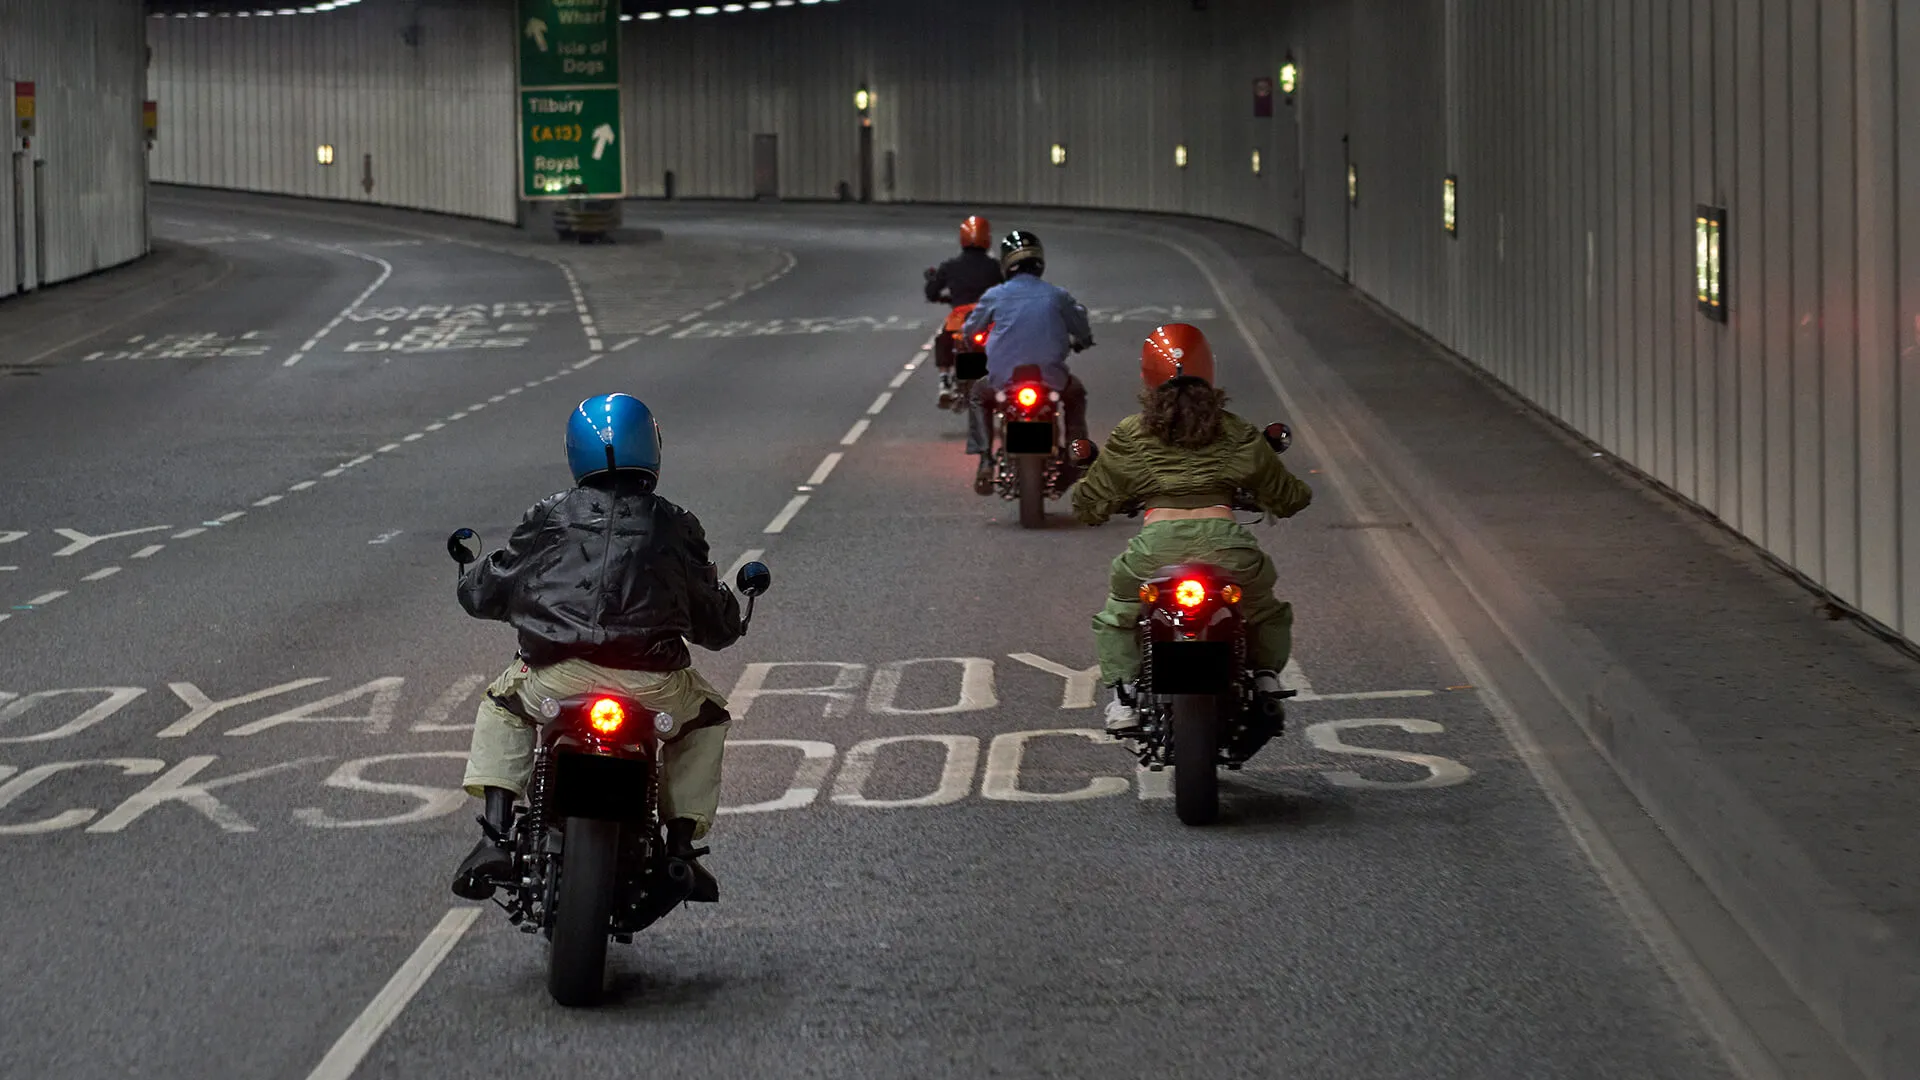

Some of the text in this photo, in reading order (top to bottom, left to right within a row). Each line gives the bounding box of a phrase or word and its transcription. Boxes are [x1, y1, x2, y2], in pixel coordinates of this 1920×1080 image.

[557, 9, 606, 24] Wharf
[563, 58, 604, 76] Dogs
[529, 97, 584, 115] Tilbury
[531, 124, 582, 143] (A13)
[533, 155, 580, 173] Royal
[728, 652, 1435, 722] ROYL
